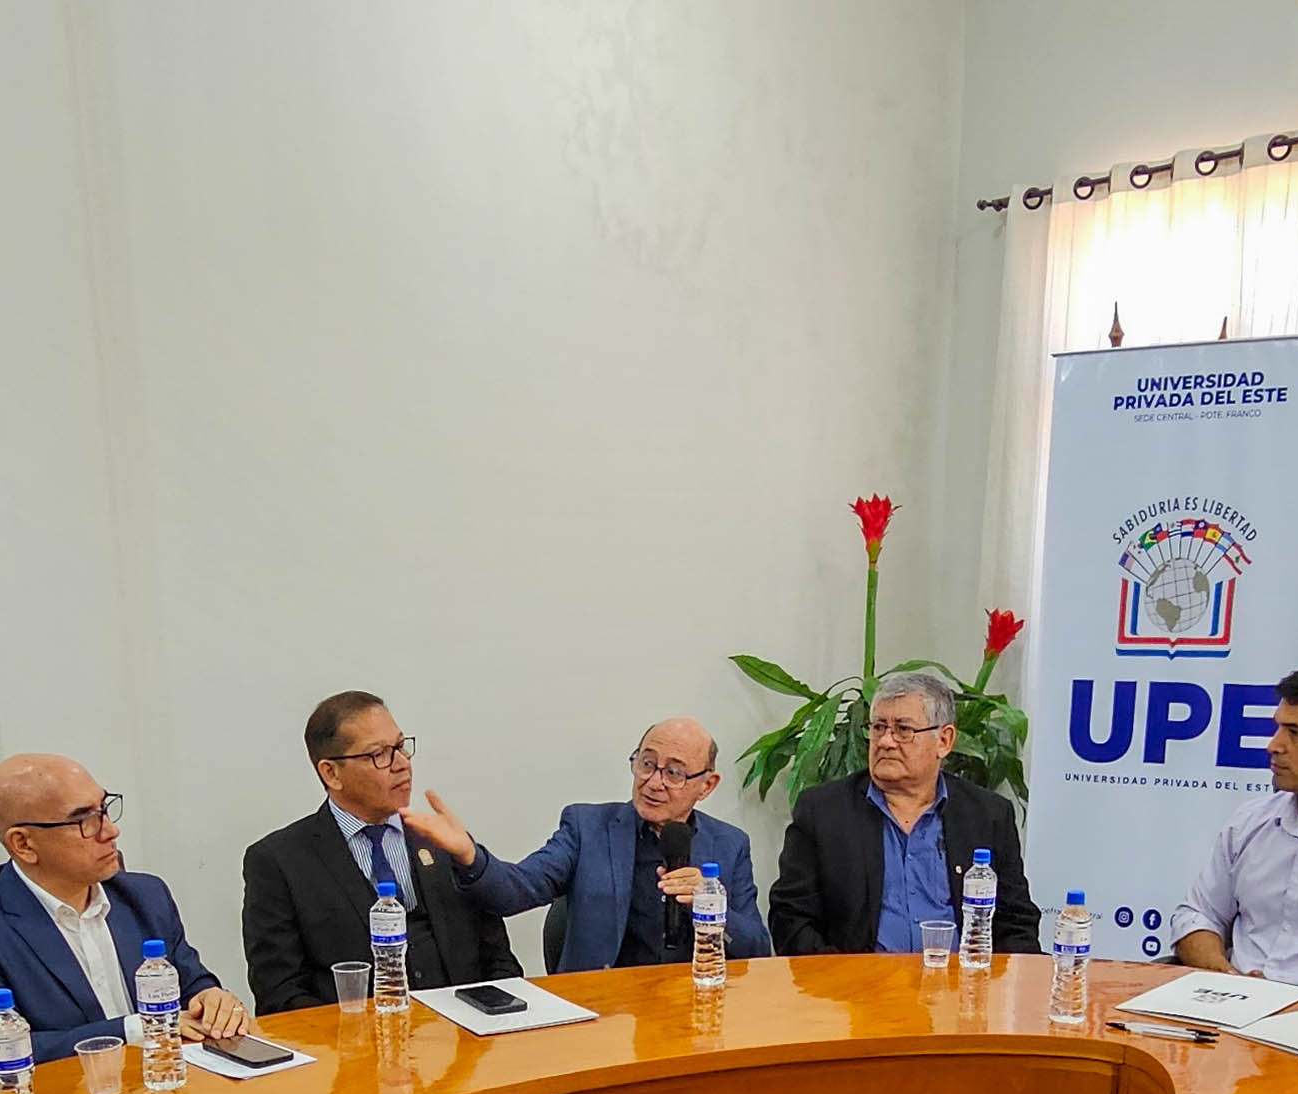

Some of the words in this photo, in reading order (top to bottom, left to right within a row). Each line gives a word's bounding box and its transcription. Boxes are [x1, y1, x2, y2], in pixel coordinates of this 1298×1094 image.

[1137, 372, 1265, 392] UNIVERSIDAD
[1113, 393, 1195, 410] PRIVADA
[1200, 390, 1236, 406] DEL
[1241, 387, 1288, 404] ESTE
[1134, 413, 1154, 423] SEDE
[1156, 412, 1194, 422] CENTRAL
[1225, 409, 1262, 419] FRANCO
[1112, 498, 1180, 545] SABIDURIA
[1184, 496, 1199, 511] ES
[1202, 498, 1258, 542] LIBERTAD
[1069, 679, 1280, 769] UPE
[1065, 773, 1148, 786] UNIVERSIDAD
[1154, 778, 1208, 789] PRIVADA
[1215, 781, 1239, 791] DEL
